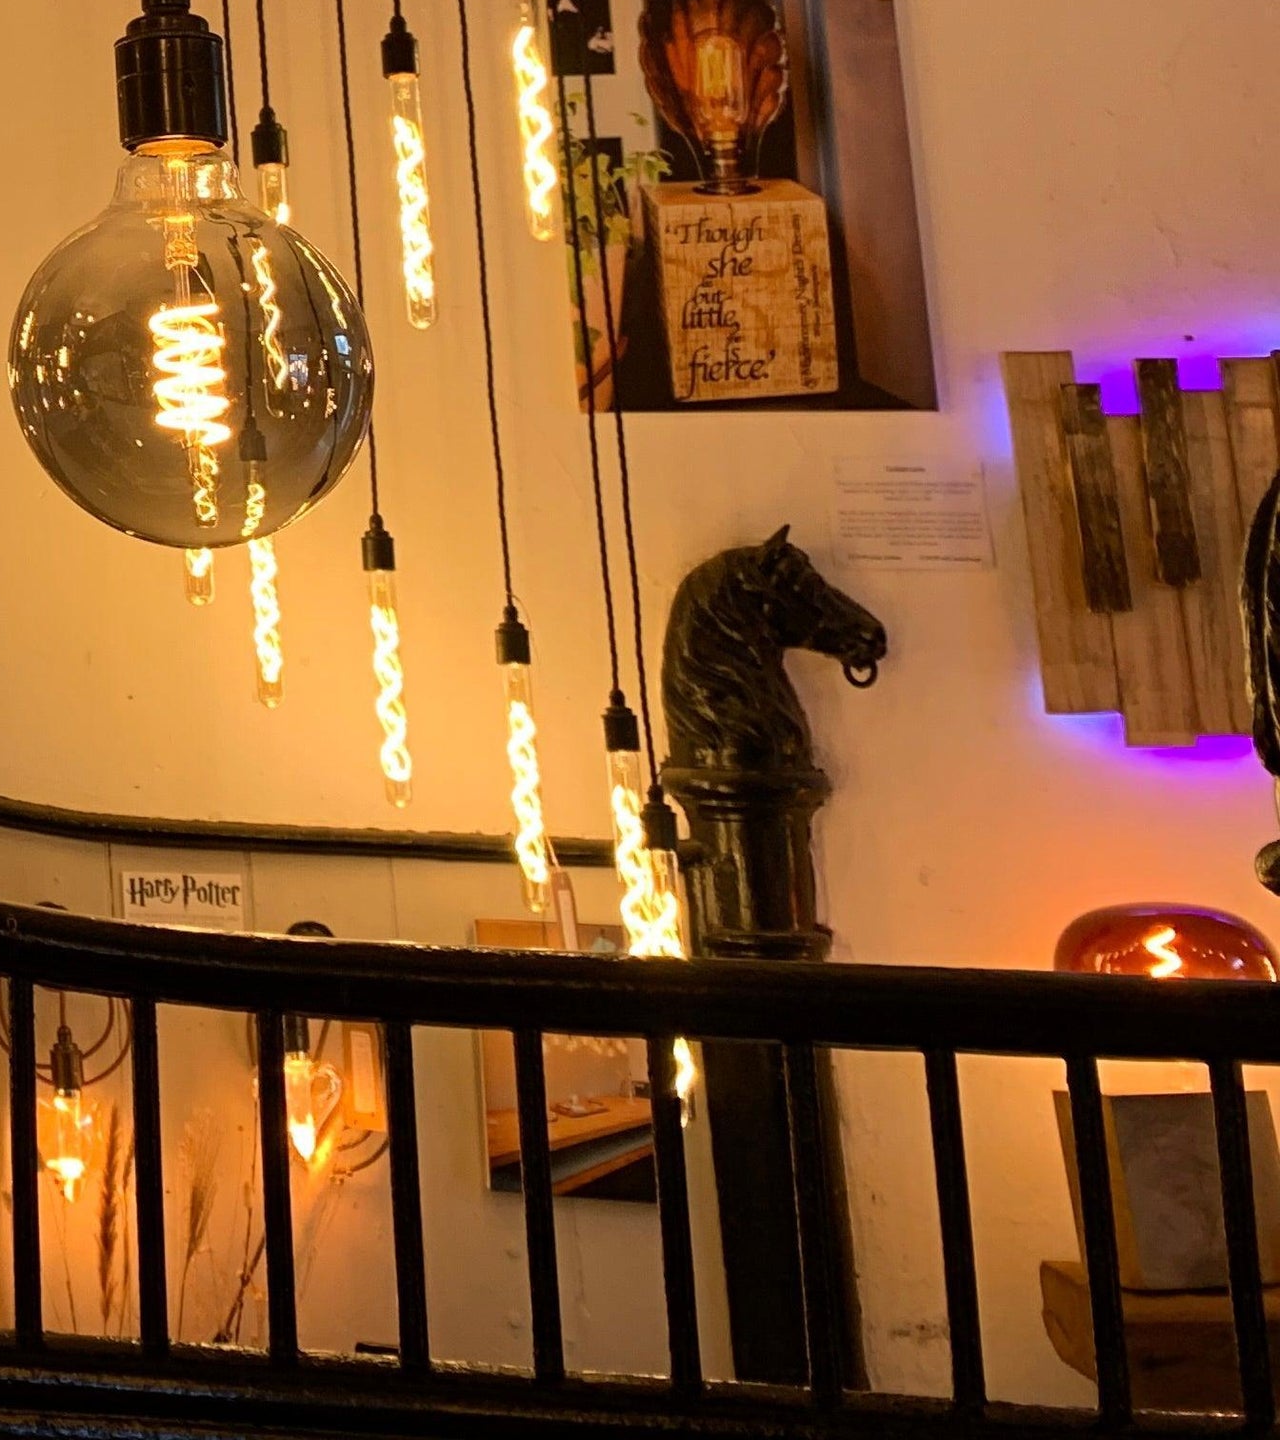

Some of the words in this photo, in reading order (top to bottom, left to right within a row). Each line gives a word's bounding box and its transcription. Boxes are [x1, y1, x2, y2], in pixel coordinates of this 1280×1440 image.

[706, 244, 753, 278] she
[692, 285, 732, 304] but
[127, 877, 180, 907] Harry
[181, 874, 240, 911] Potter
